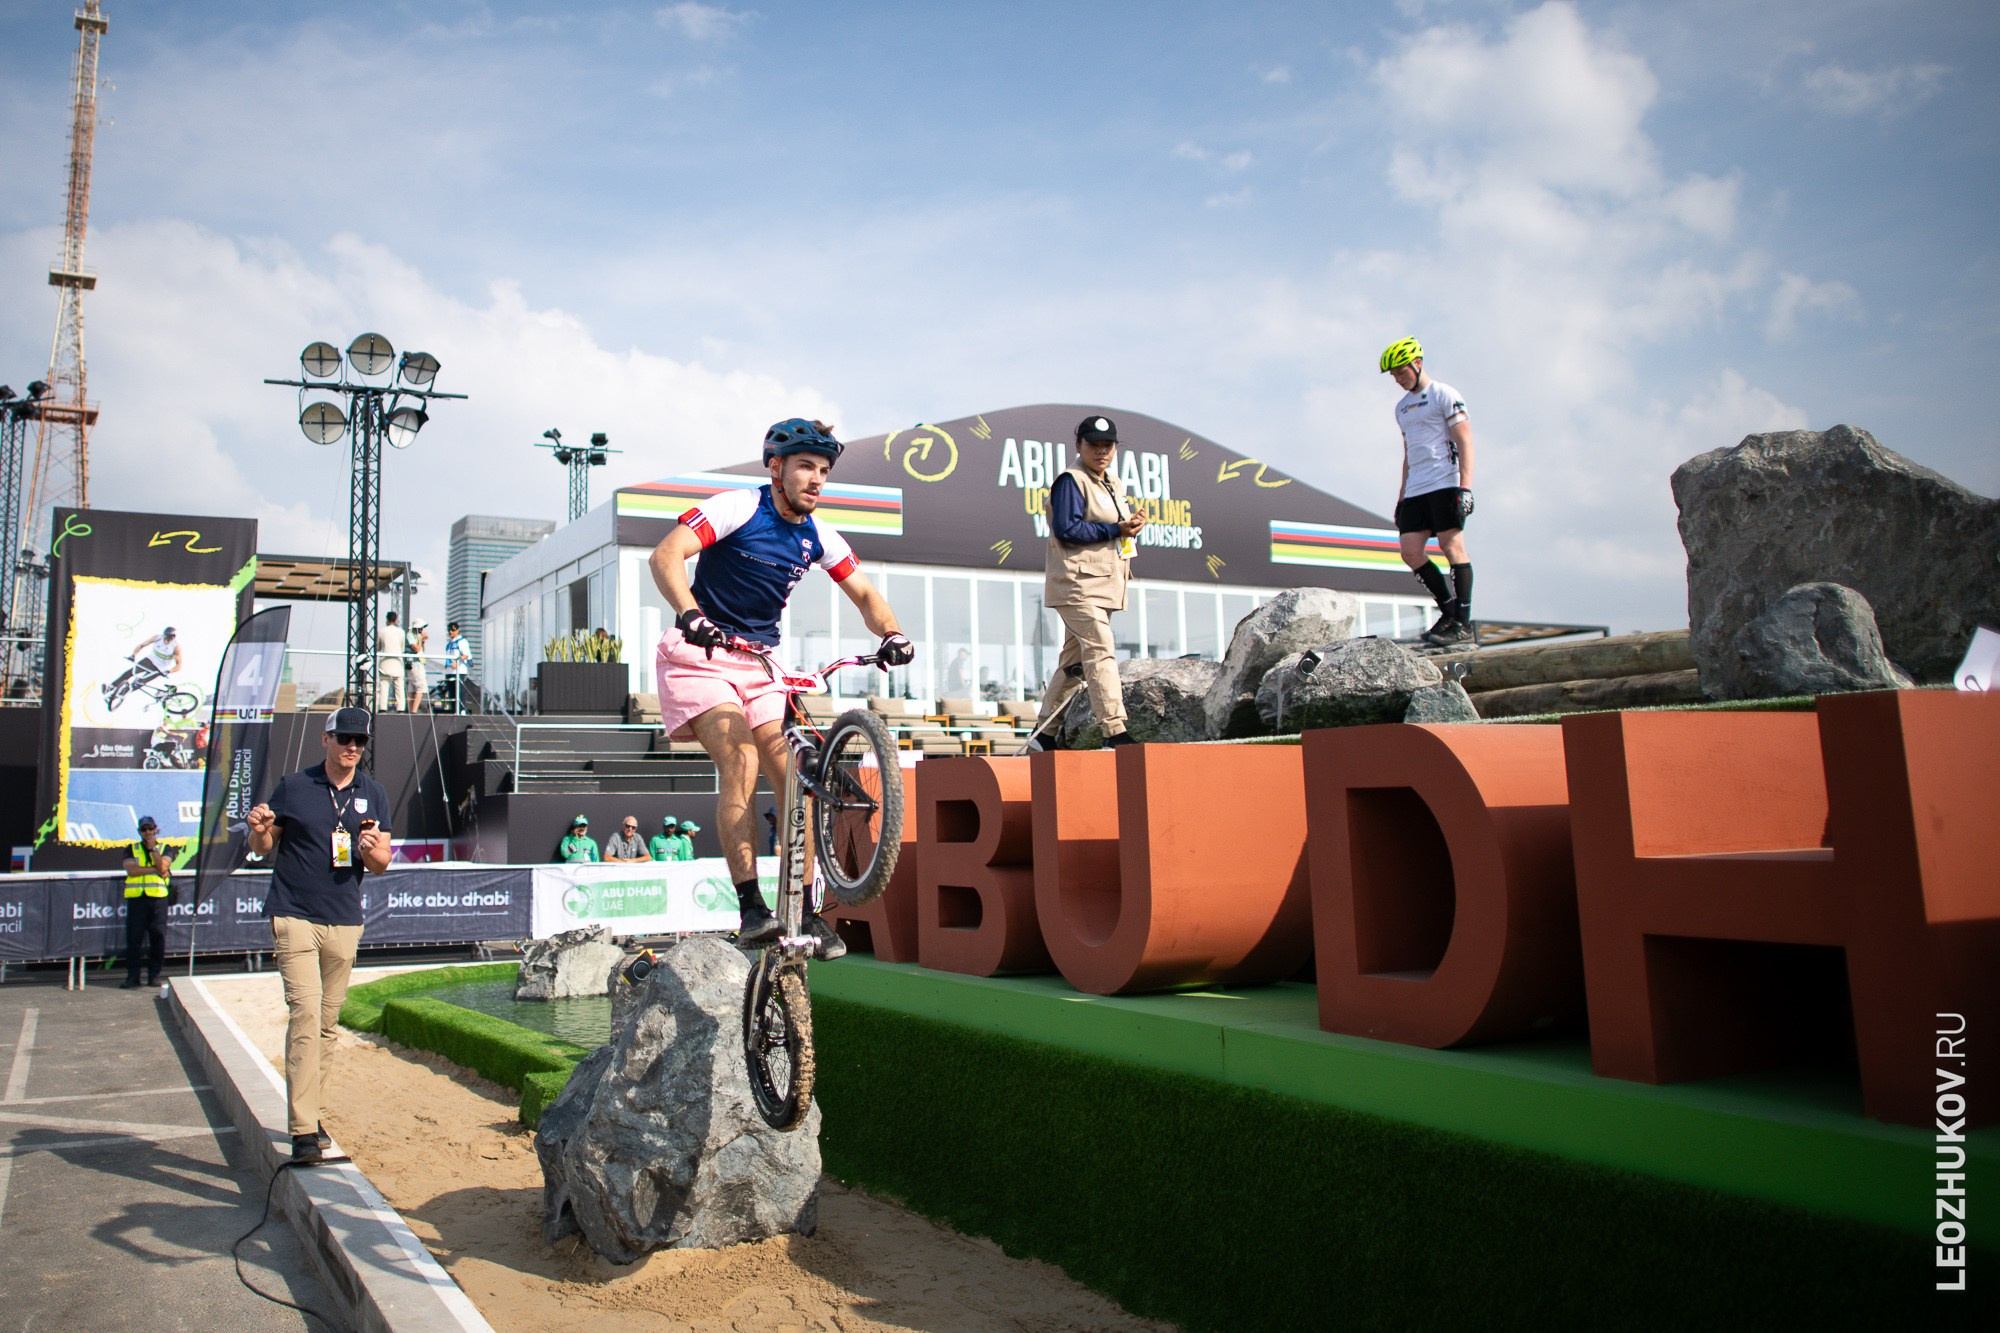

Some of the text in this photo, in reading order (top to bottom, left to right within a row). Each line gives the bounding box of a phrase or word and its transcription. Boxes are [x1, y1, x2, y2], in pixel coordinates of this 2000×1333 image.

[998, 438, 1067, 488] ABU
[1025, 488, 1191, 526] UC YCLING
[1140, 523, 1203, 550] IONSHIPS
[237, 654, 263, 696] 4
[238, 707, 258, 720] UCI
[226, 749, 242, 819] Abu Dhabi
[240, 748, 252, 819] Sports Council
[824, 744, 1155, 997] ABU
[388, 891, 510, 908] bike abu dhabi
[602, 885, 662, 898] ABU DHABI
[73, 903, 113, 919] bike
[236, 898, 264, 914] bik
[601, 900, 624, 911] UAE
